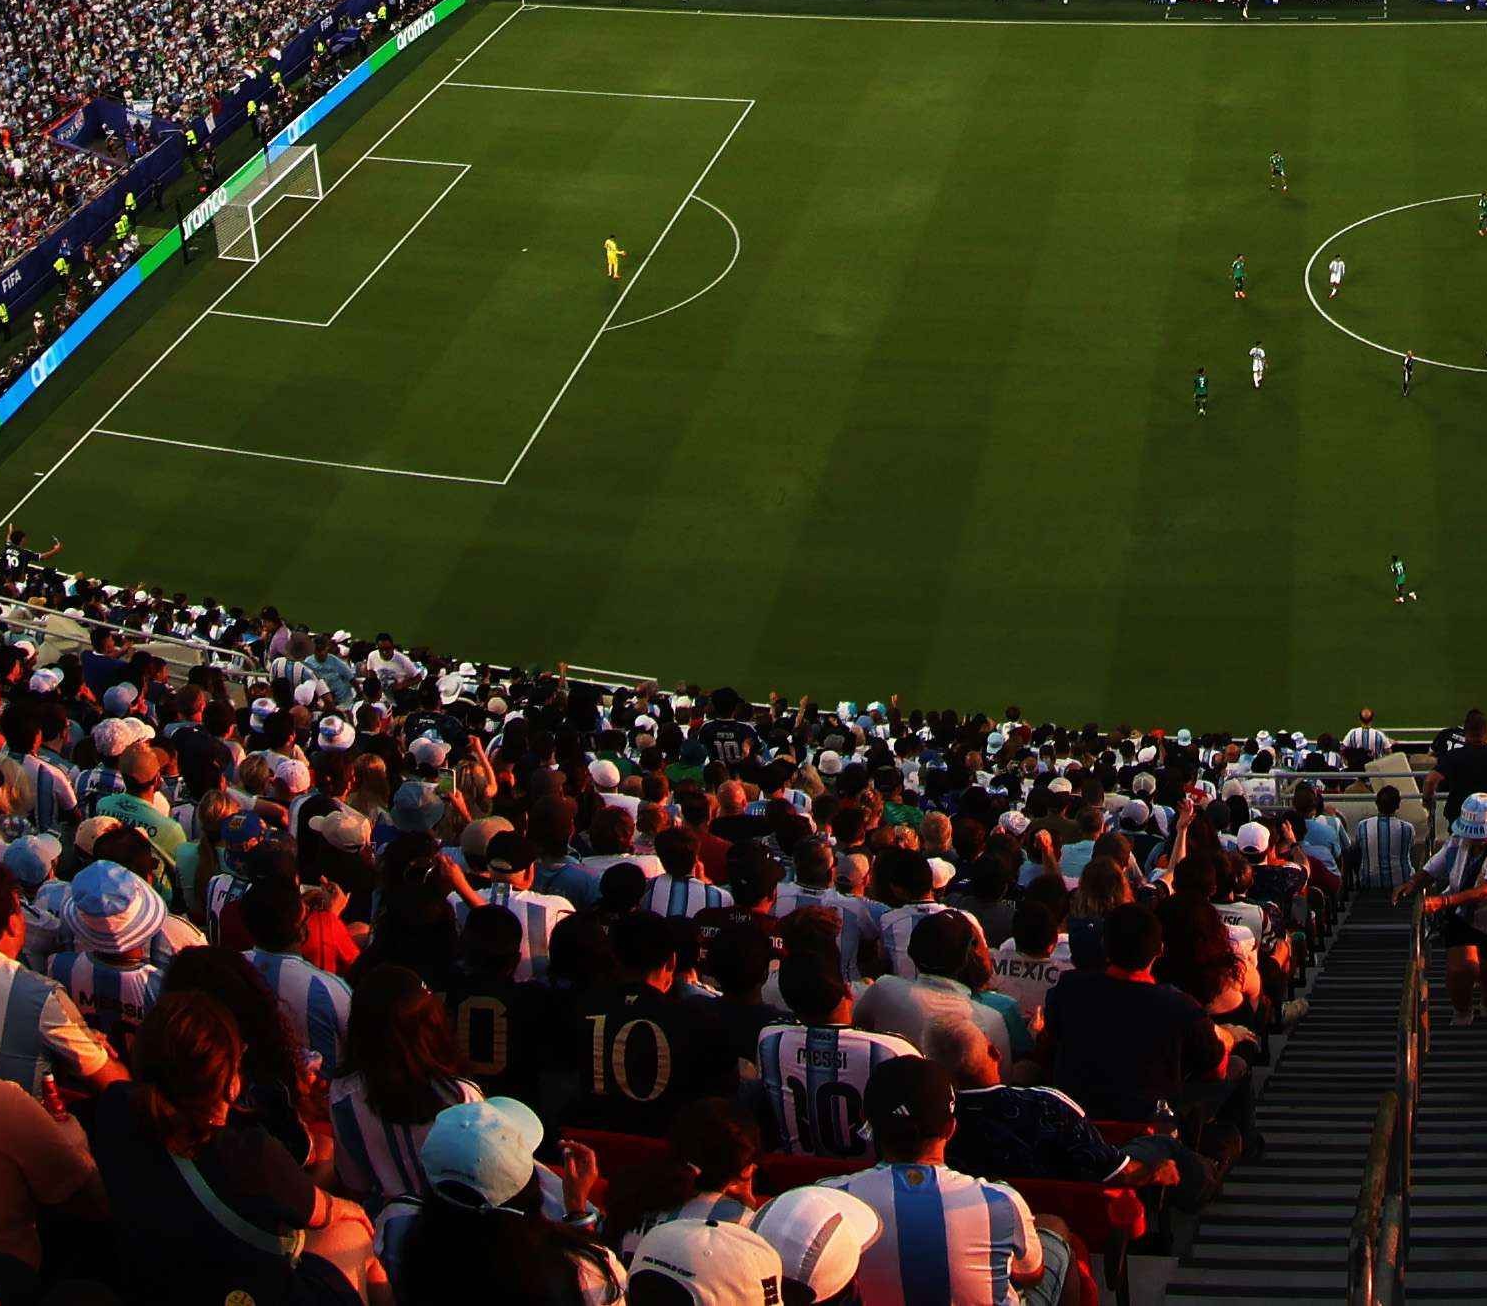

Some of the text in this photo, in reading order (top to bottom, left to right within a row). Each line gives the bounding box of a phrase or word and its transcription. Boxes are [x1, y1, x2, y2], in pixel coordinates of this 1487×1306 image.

[396, 9, 436, 52] aramco
[1, 268, 22, 294] FIFA
[991, 958, 1062, 987] MEXIC
[457, 995, 509, 1077] 0
[584, 1013, 673, 1102] 10
[796, 1048, 849, 1071] MESSI
[784, 1077, 868, 1158] 10
